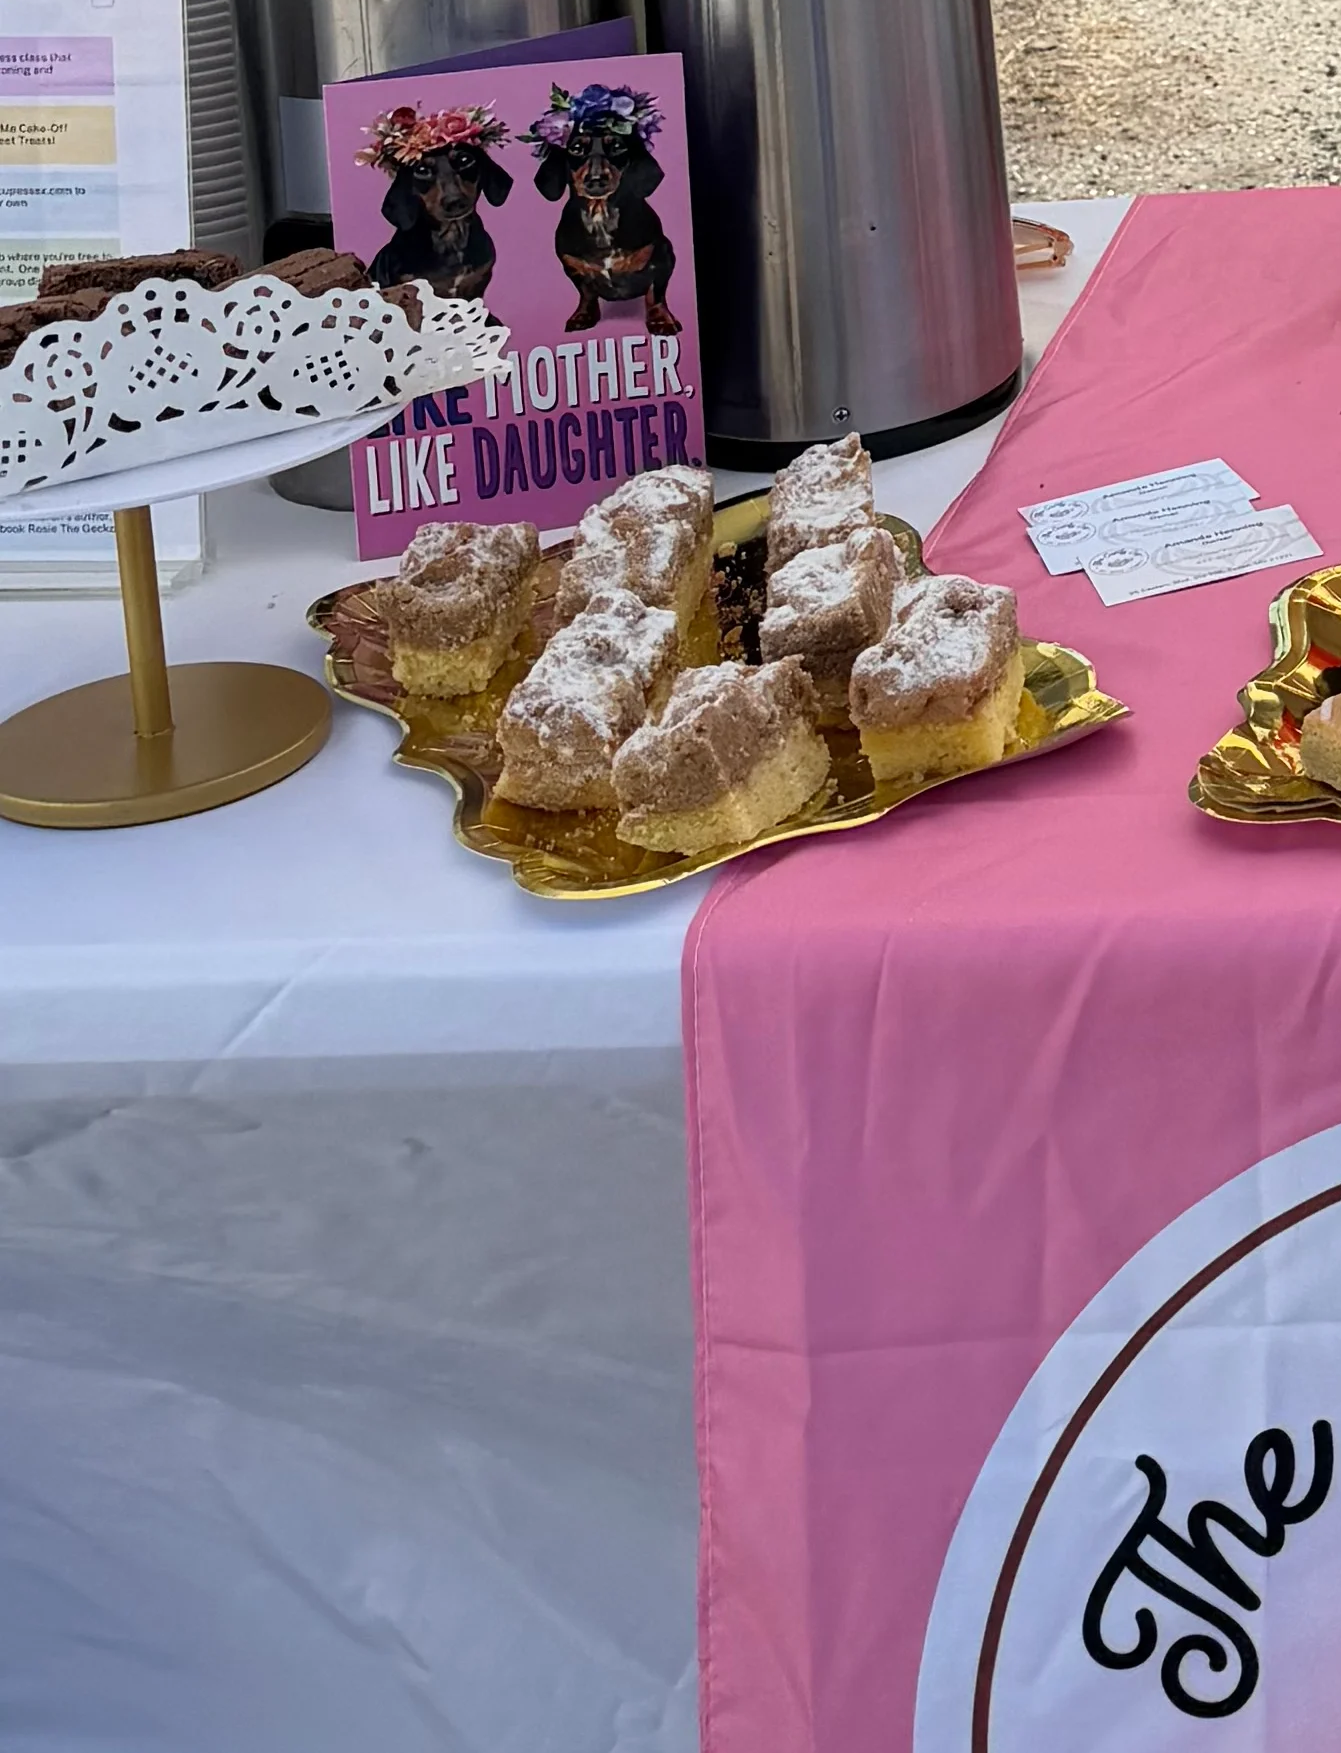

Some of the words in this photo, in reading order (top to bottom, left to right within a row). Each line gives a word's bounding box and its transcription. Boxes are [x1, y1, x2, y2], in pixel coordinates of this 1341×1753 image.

[484, 334, 696, 419] MOTHER,
[366, 432, 460, 517] LIKE
[472, 400, 703, 499] DAUGHTER.
[1082, 1419, 1335, 1719] The
